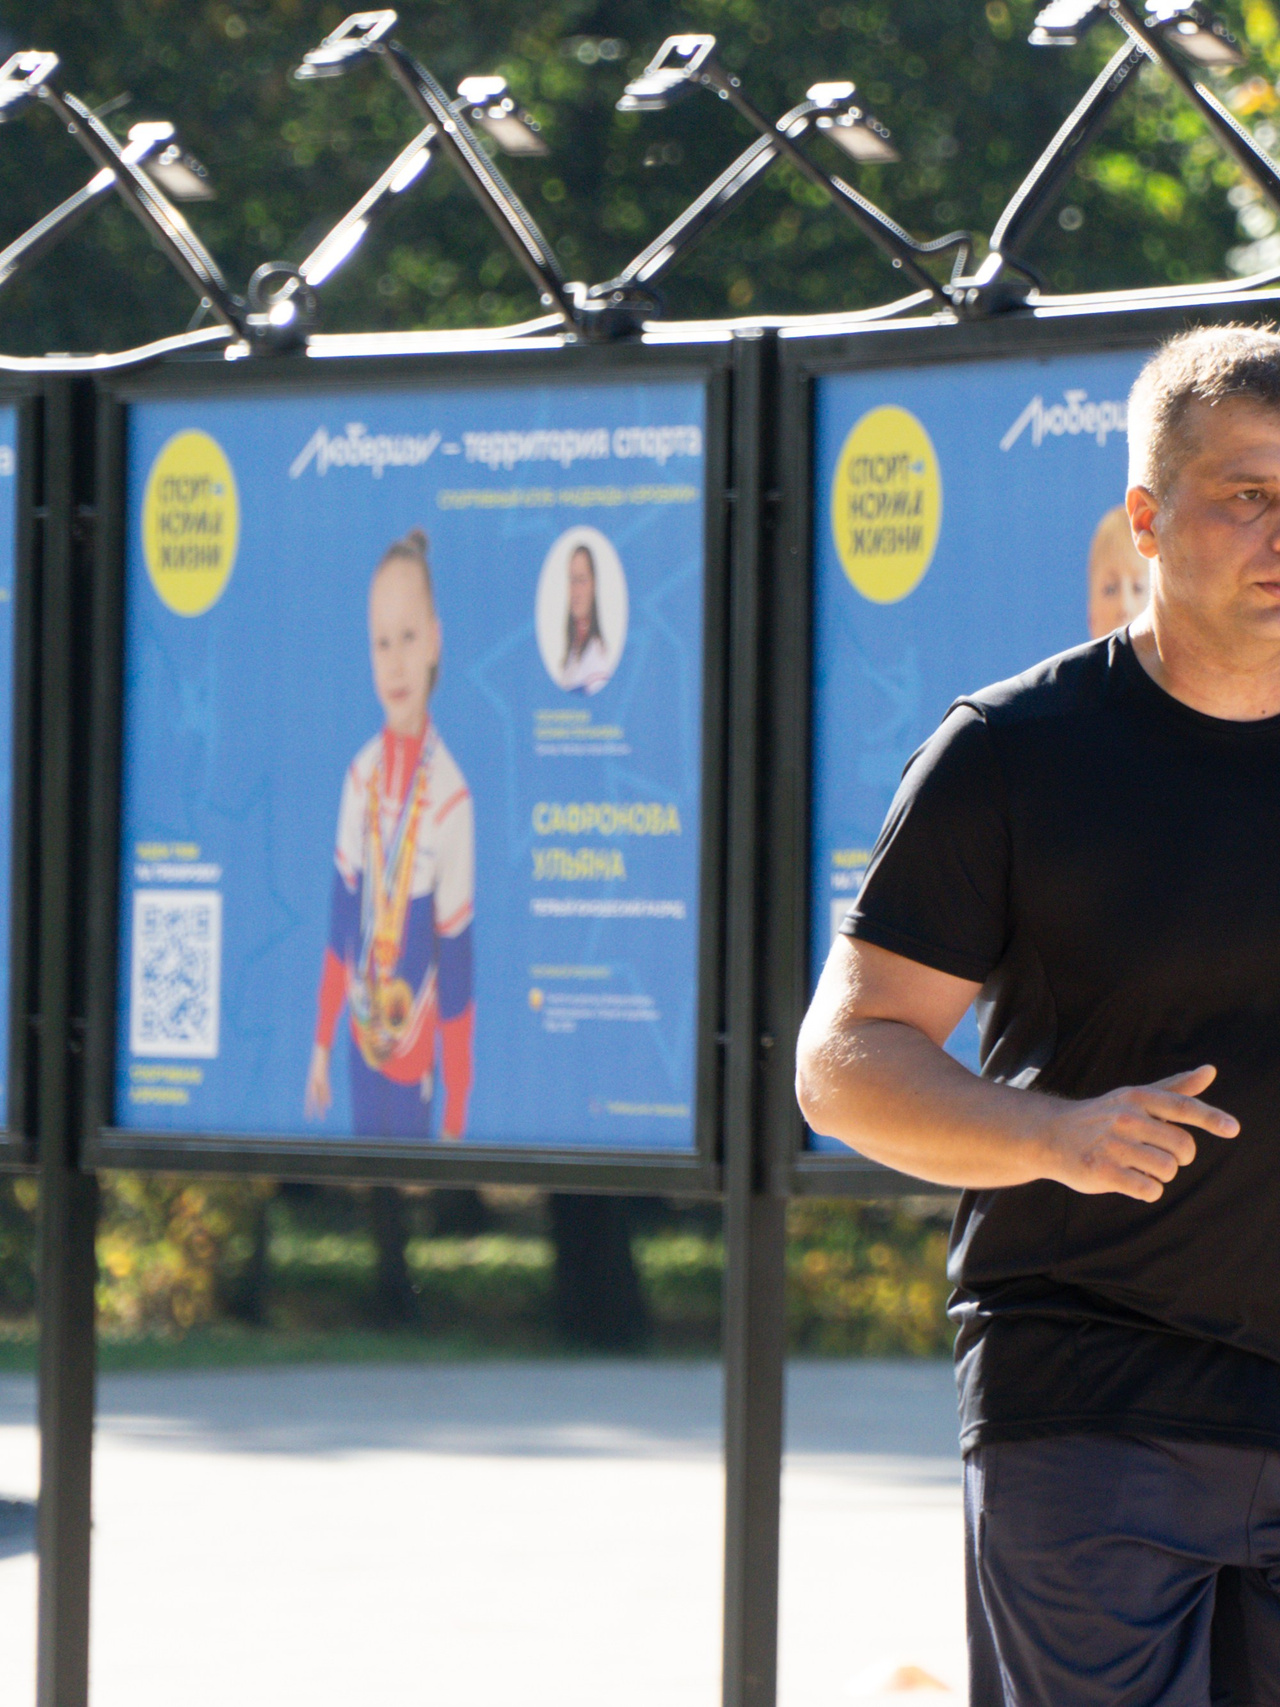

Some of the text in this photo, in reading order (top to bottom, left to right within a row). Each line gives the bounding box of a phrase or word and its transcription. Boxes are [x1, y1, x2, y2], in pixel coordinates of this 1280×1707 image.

[999, 389, 1129, 451] Люберц
[462, 428, 611, 471] территория
[613, 425, 701, 467] спорта
[848, 453, 910, 485] СПОРТ
